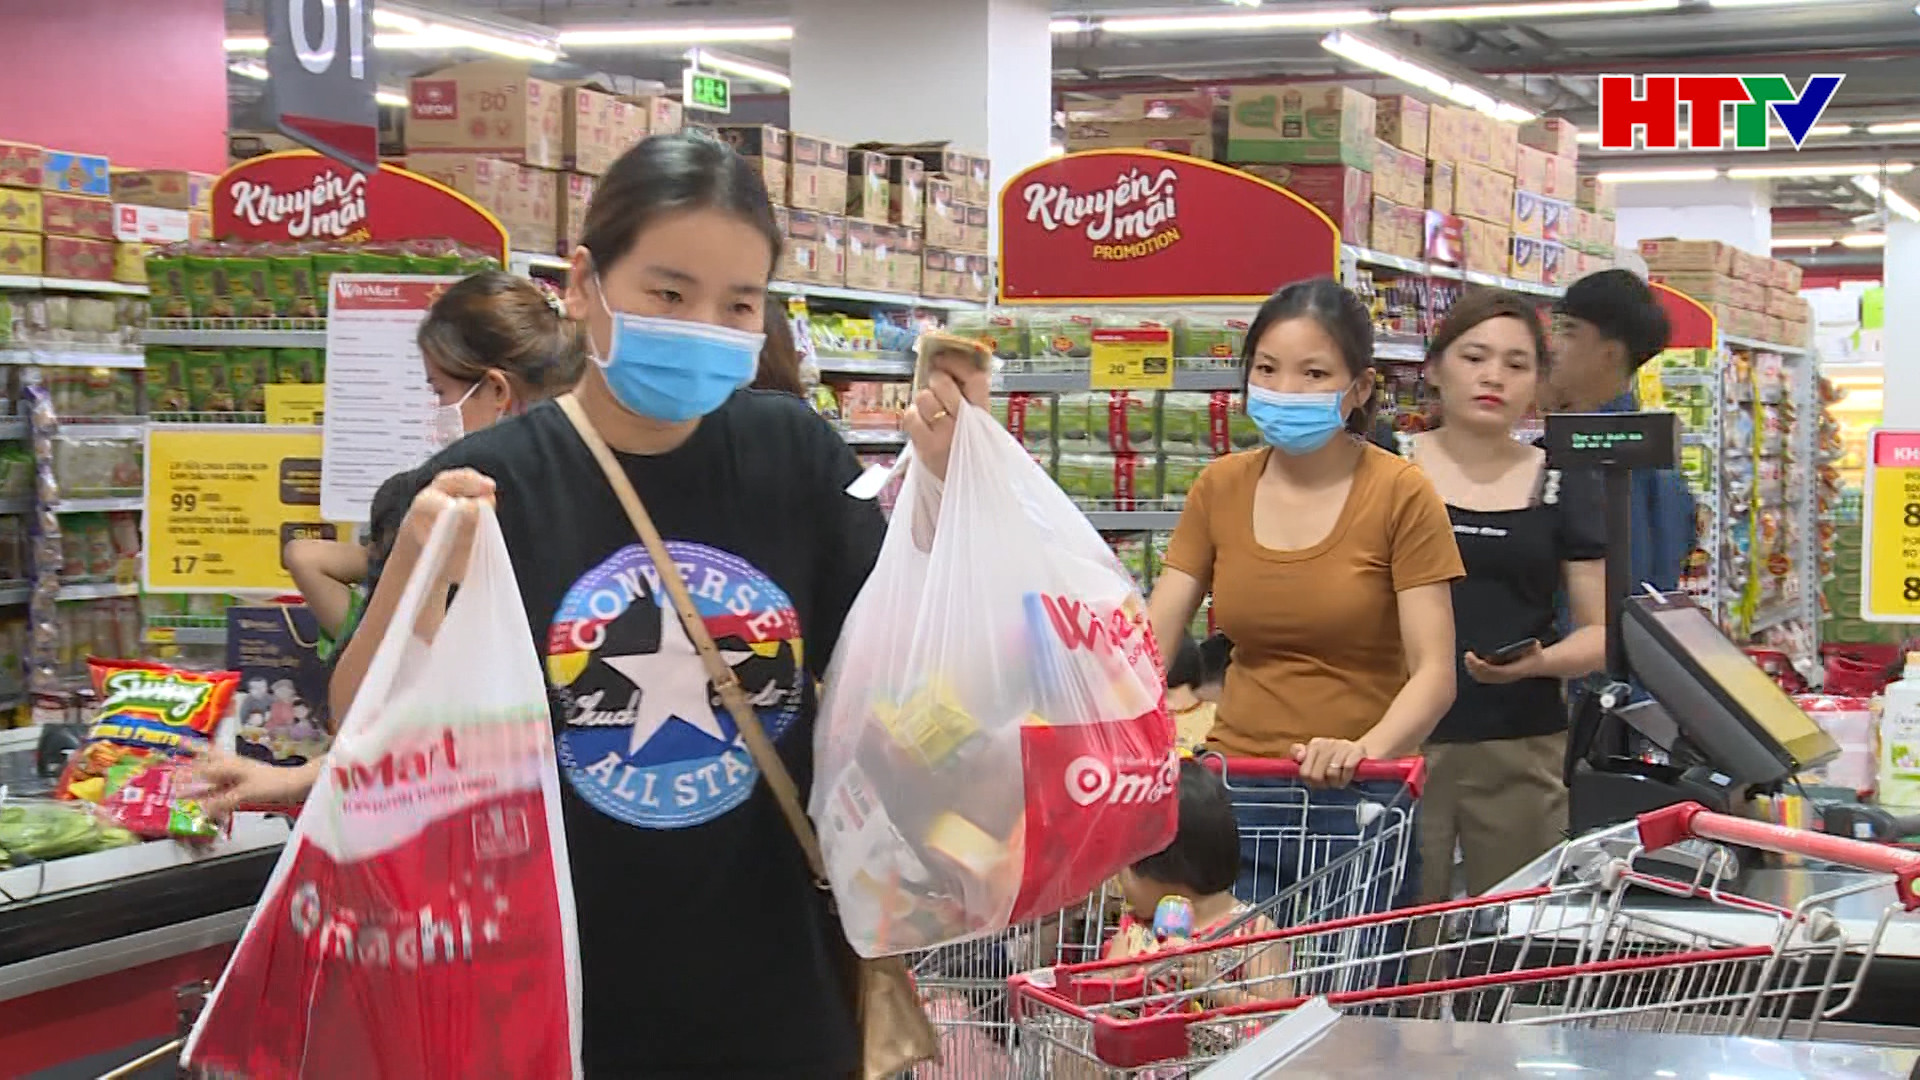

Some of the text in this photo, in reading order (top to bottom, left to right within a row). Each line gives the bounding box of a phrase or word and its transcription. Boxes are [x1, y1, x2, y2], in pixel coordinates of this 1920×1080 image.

[231, 170, 367, 237] Khuyến
[312, 186, 366, 237] mãi
[1024, 168, 1178, 240] Khuyến
[1114, 186, 1176, 240] mãi
[1092, 228, 1180, 260] PROMOTION
[338, 284, 399, 298] WinMart
[172, 493, 196, 512] 99
[172, 555, 199, 574] 17
[570, 562, 783, 650] CONVERSE
[586, 731, 752, 808] ALL STA
